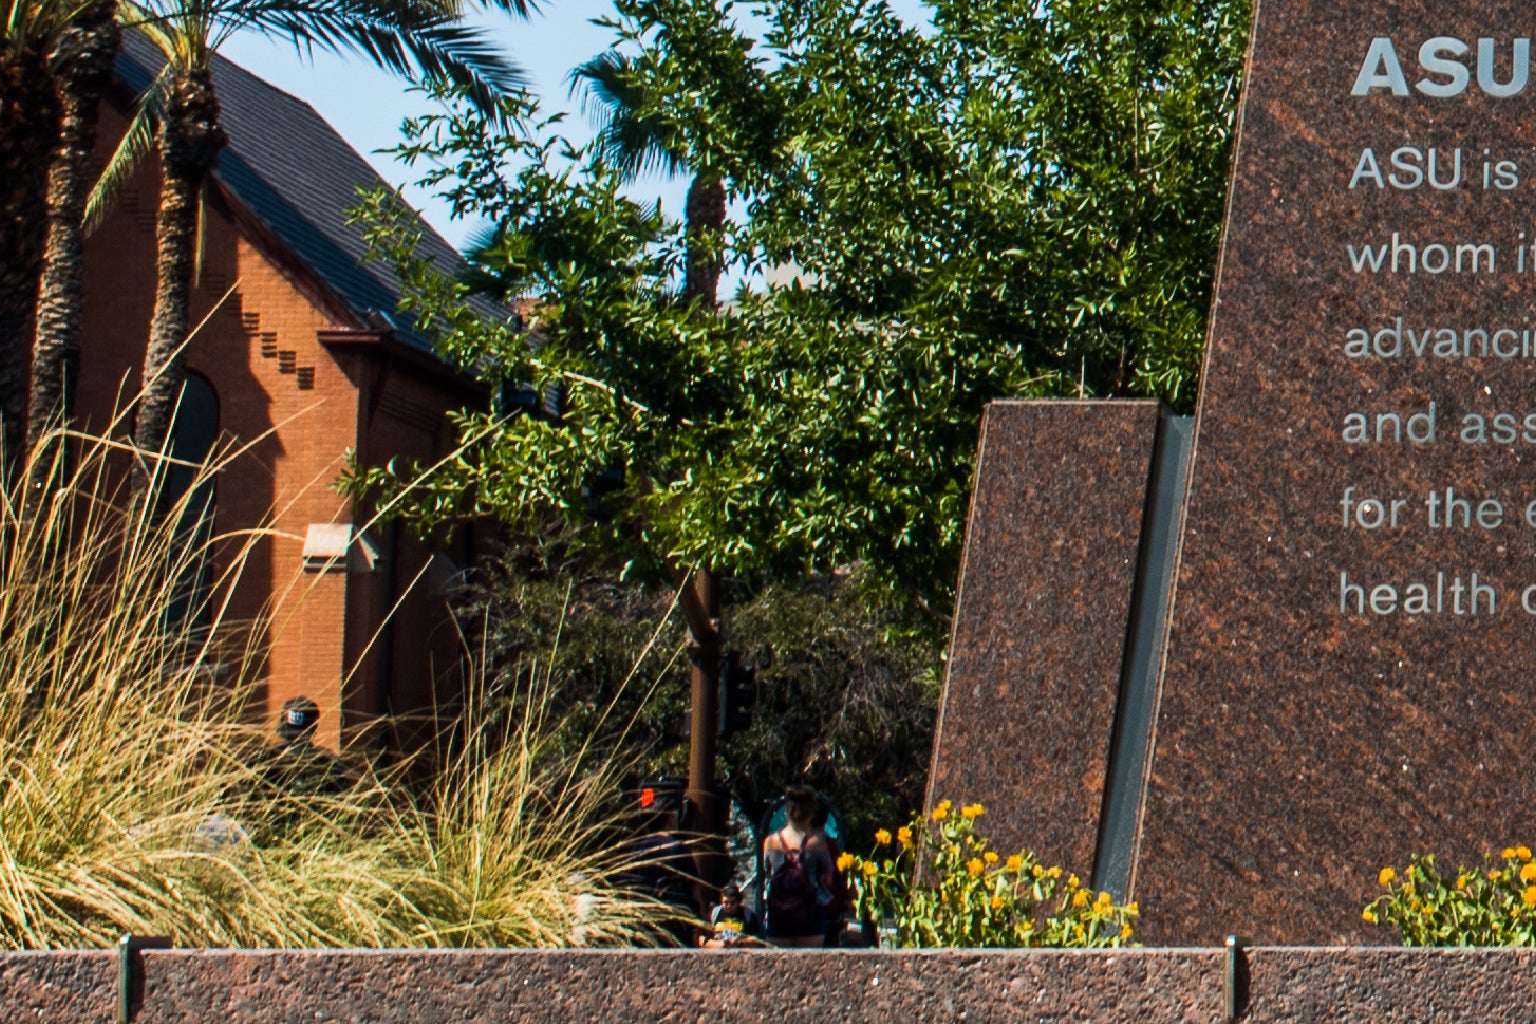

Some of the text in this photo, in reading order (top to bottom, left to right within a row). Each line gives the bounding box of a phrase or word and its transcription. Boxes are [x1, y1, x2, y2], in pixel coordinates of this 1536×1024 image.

[1351, 37, 1529, 97] ASU
[1349, 147, 1460, 189] ASU
[1484, 148, 1518, 189] is
[1348, 233, 1494, 273] whom
[1343, 402, 1435, 442] and
[1341, 487, 1402, 528] for
[1426, 487, 1502, 528] the
[1341, 572, 1495, 614] health
